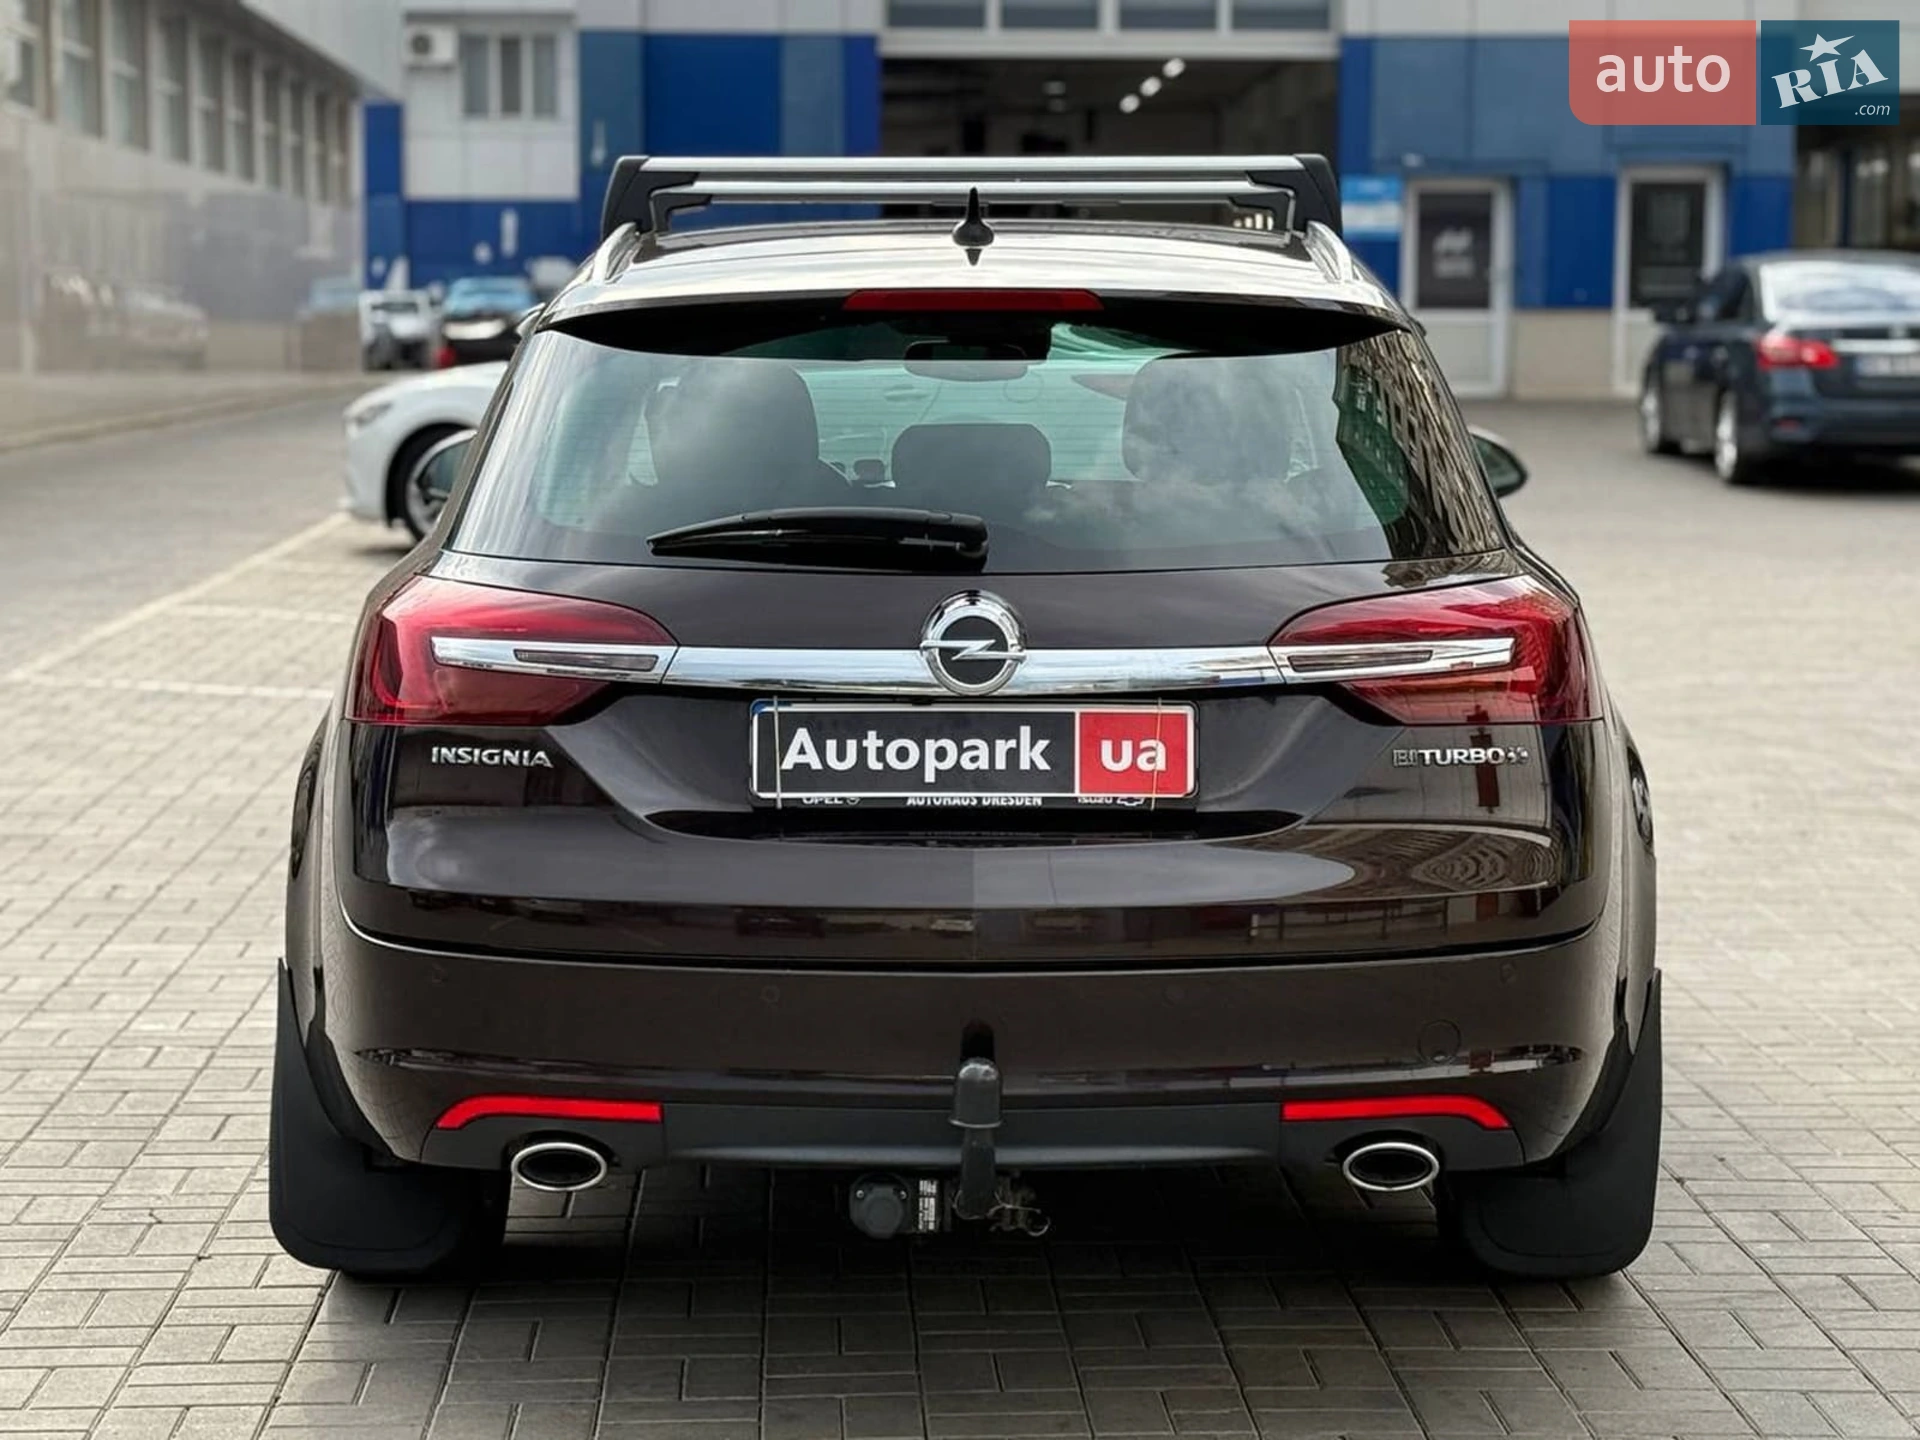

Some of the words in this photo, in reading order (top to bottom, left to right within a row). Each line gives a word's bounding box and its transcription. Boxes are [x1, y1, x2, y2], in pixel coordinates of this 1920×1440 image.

[431, 746, 554, 768] INSIGNIA
[780, 725, 1051, 783] Autopark
[1099, 739, 1167, 772] ua
